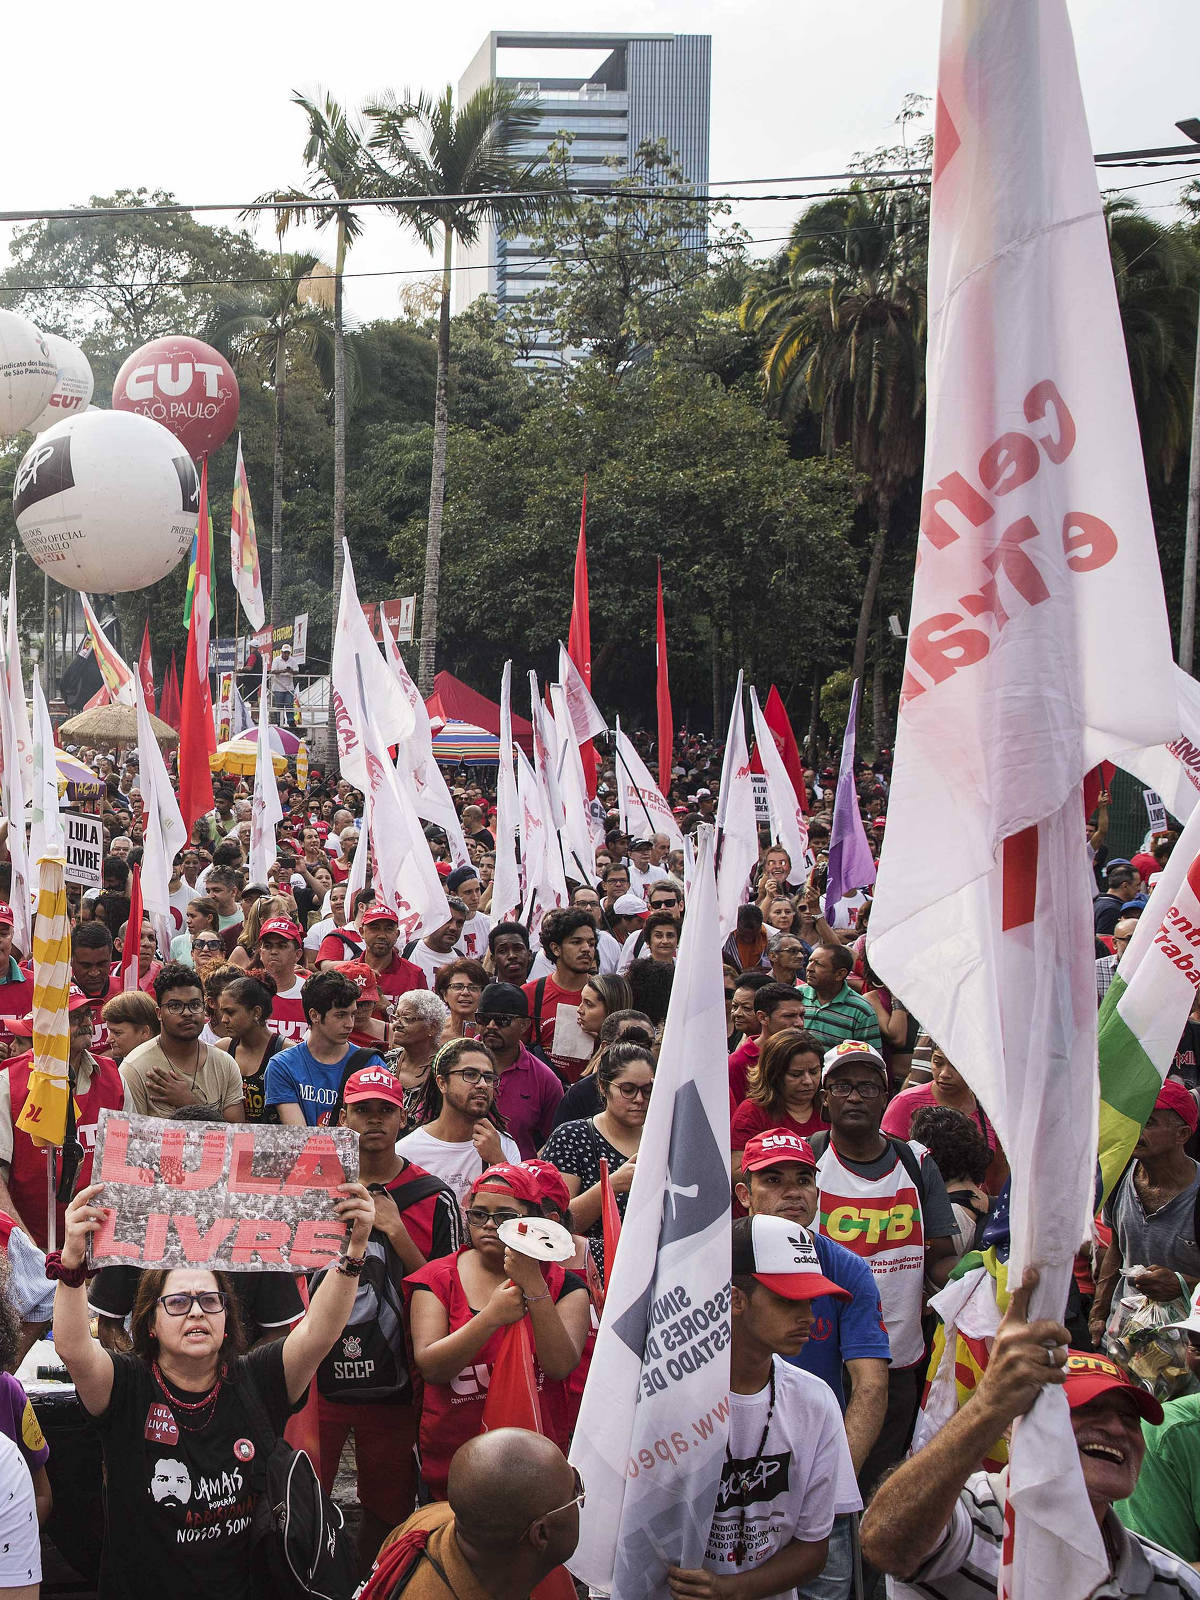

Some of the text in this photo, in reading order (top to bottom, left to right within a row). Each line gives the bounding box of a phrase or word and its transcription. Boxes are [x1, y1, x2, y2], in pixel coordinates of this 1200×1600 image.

[12, 368, 24, 376] São
[126, 363, 223, 401] CUT
[48, 394, 83, 409] CUT
[171, 402, 217, 419] PAULO
[47, 530, 86, 545] OFICIAL
[69, 821, 99, 845] LULA
[66, 846, 100, 871] LIVRE
[360, 1072, 389, 1084] CUT
[762, 1135, 797, 1147] CUT
[101, 1119, 347, 1198] LULA
[826, 1204, 914, 1244] CTB
[93, 1207, 348, 1268] LIVRE
[870, 1255, 923, 1267] Trabalhadores
[899, 1262, 921, 1271] Brasil
[334, 1360, 375, 1379] SCCP
[1068, 1356, 1117, 1375] CTB
[154, 1408, 174, 1421] LULA
[194, 1467, 243, 1501] JAMAIS
[209, 1494, 236, 1510] PODERÃO
[177, 1524, 221, 1543] NOSSOS
